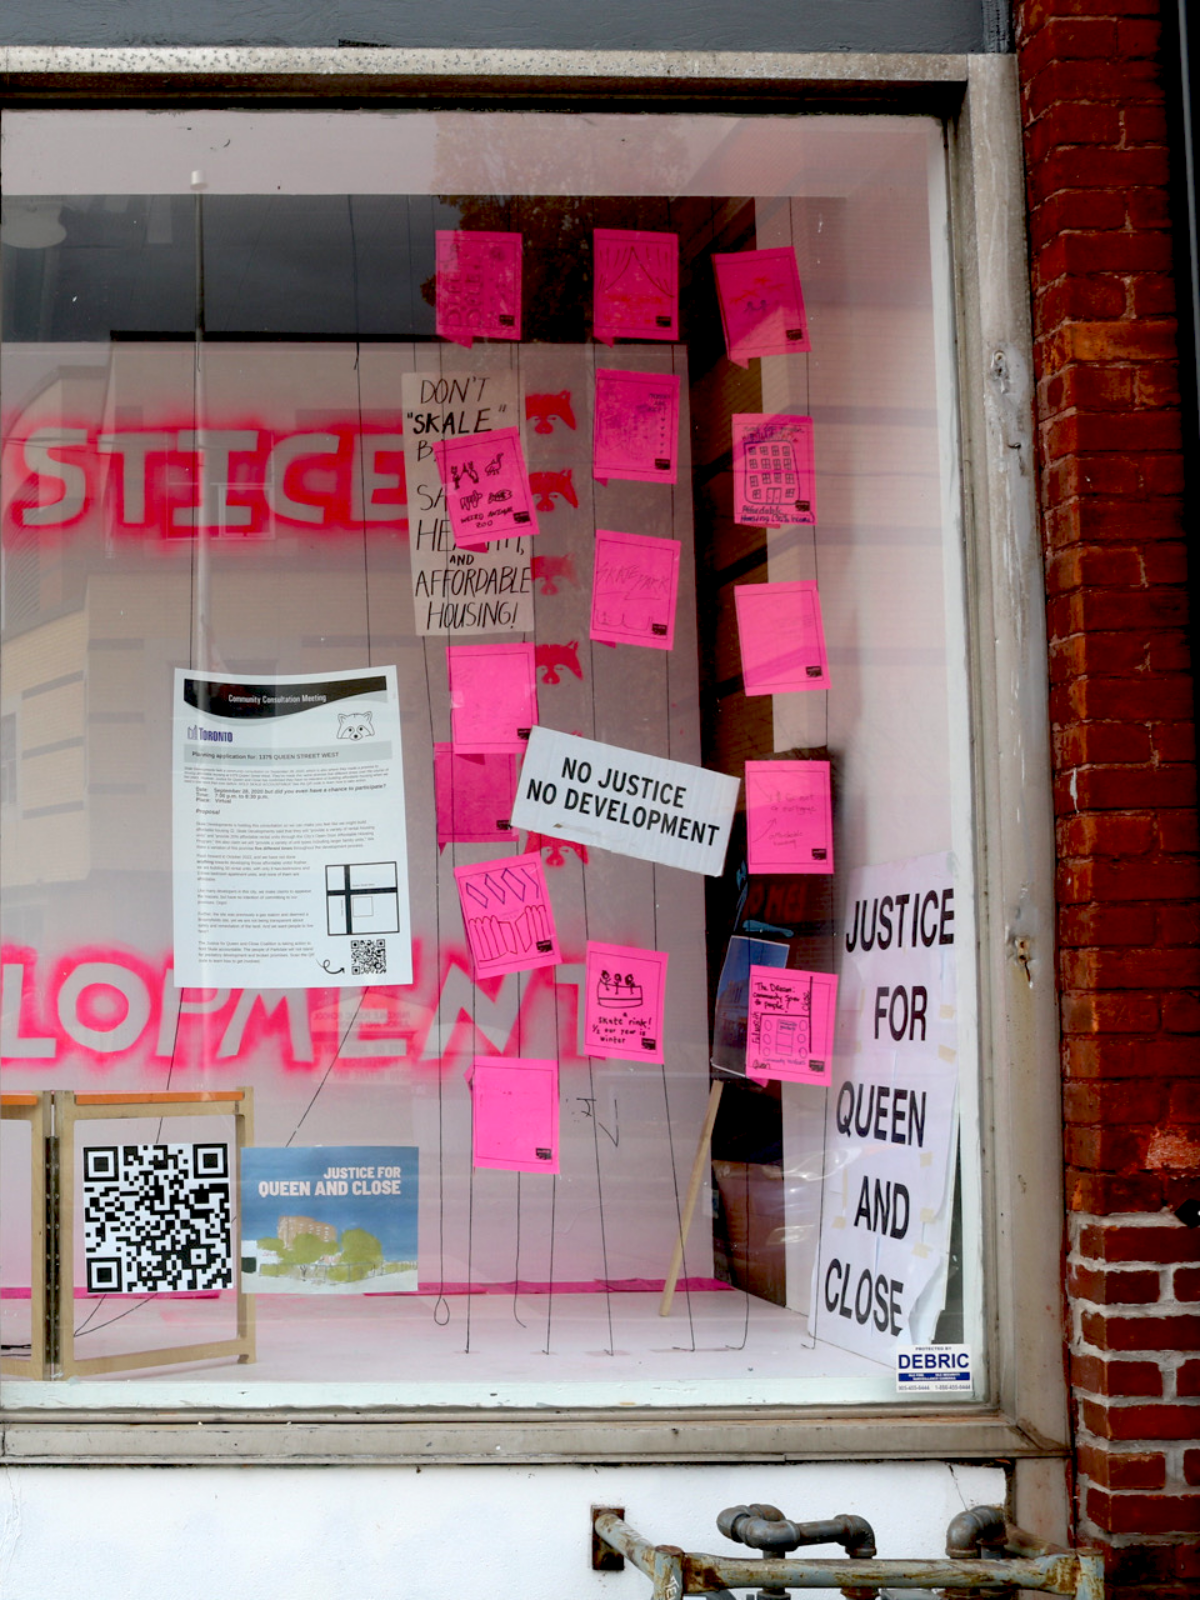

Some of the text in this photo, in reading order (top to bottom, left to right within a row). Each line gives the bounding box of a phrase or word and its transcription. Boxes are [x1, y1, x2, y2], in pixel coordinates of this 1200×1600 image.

[420, 377, 490, 404] DON'T
[449, 554, 474, 566] AND
[415, 566, 531, 598] AFFORDABLE
[426, 601, 518, 630] HOUSING!
[228, 694, 327, 704] Community Consultation Meeting
[215, 752, 246, 760] application
[561, 757, 687, 808] NO JUSTICE
[526, 779, 720, 846] NO DEVELOPMENT
[845, 888, 955, 953] JUSTICE
[874, 985, 928, 1041] FOR
[600, 1035, 625, 1044] winter
[836, 1081, 927, 1148] QUEEN
[323, 1165, 401, 1181] JUSTICE FOR
[258, 1179, 402, 1198] QUEEN AND CLOSE
[854, 1174, 910, 1239] AND
[824, 1257, 904, 1336] CLOSE
[898, 1353, 969, 1369] DEBRIC
